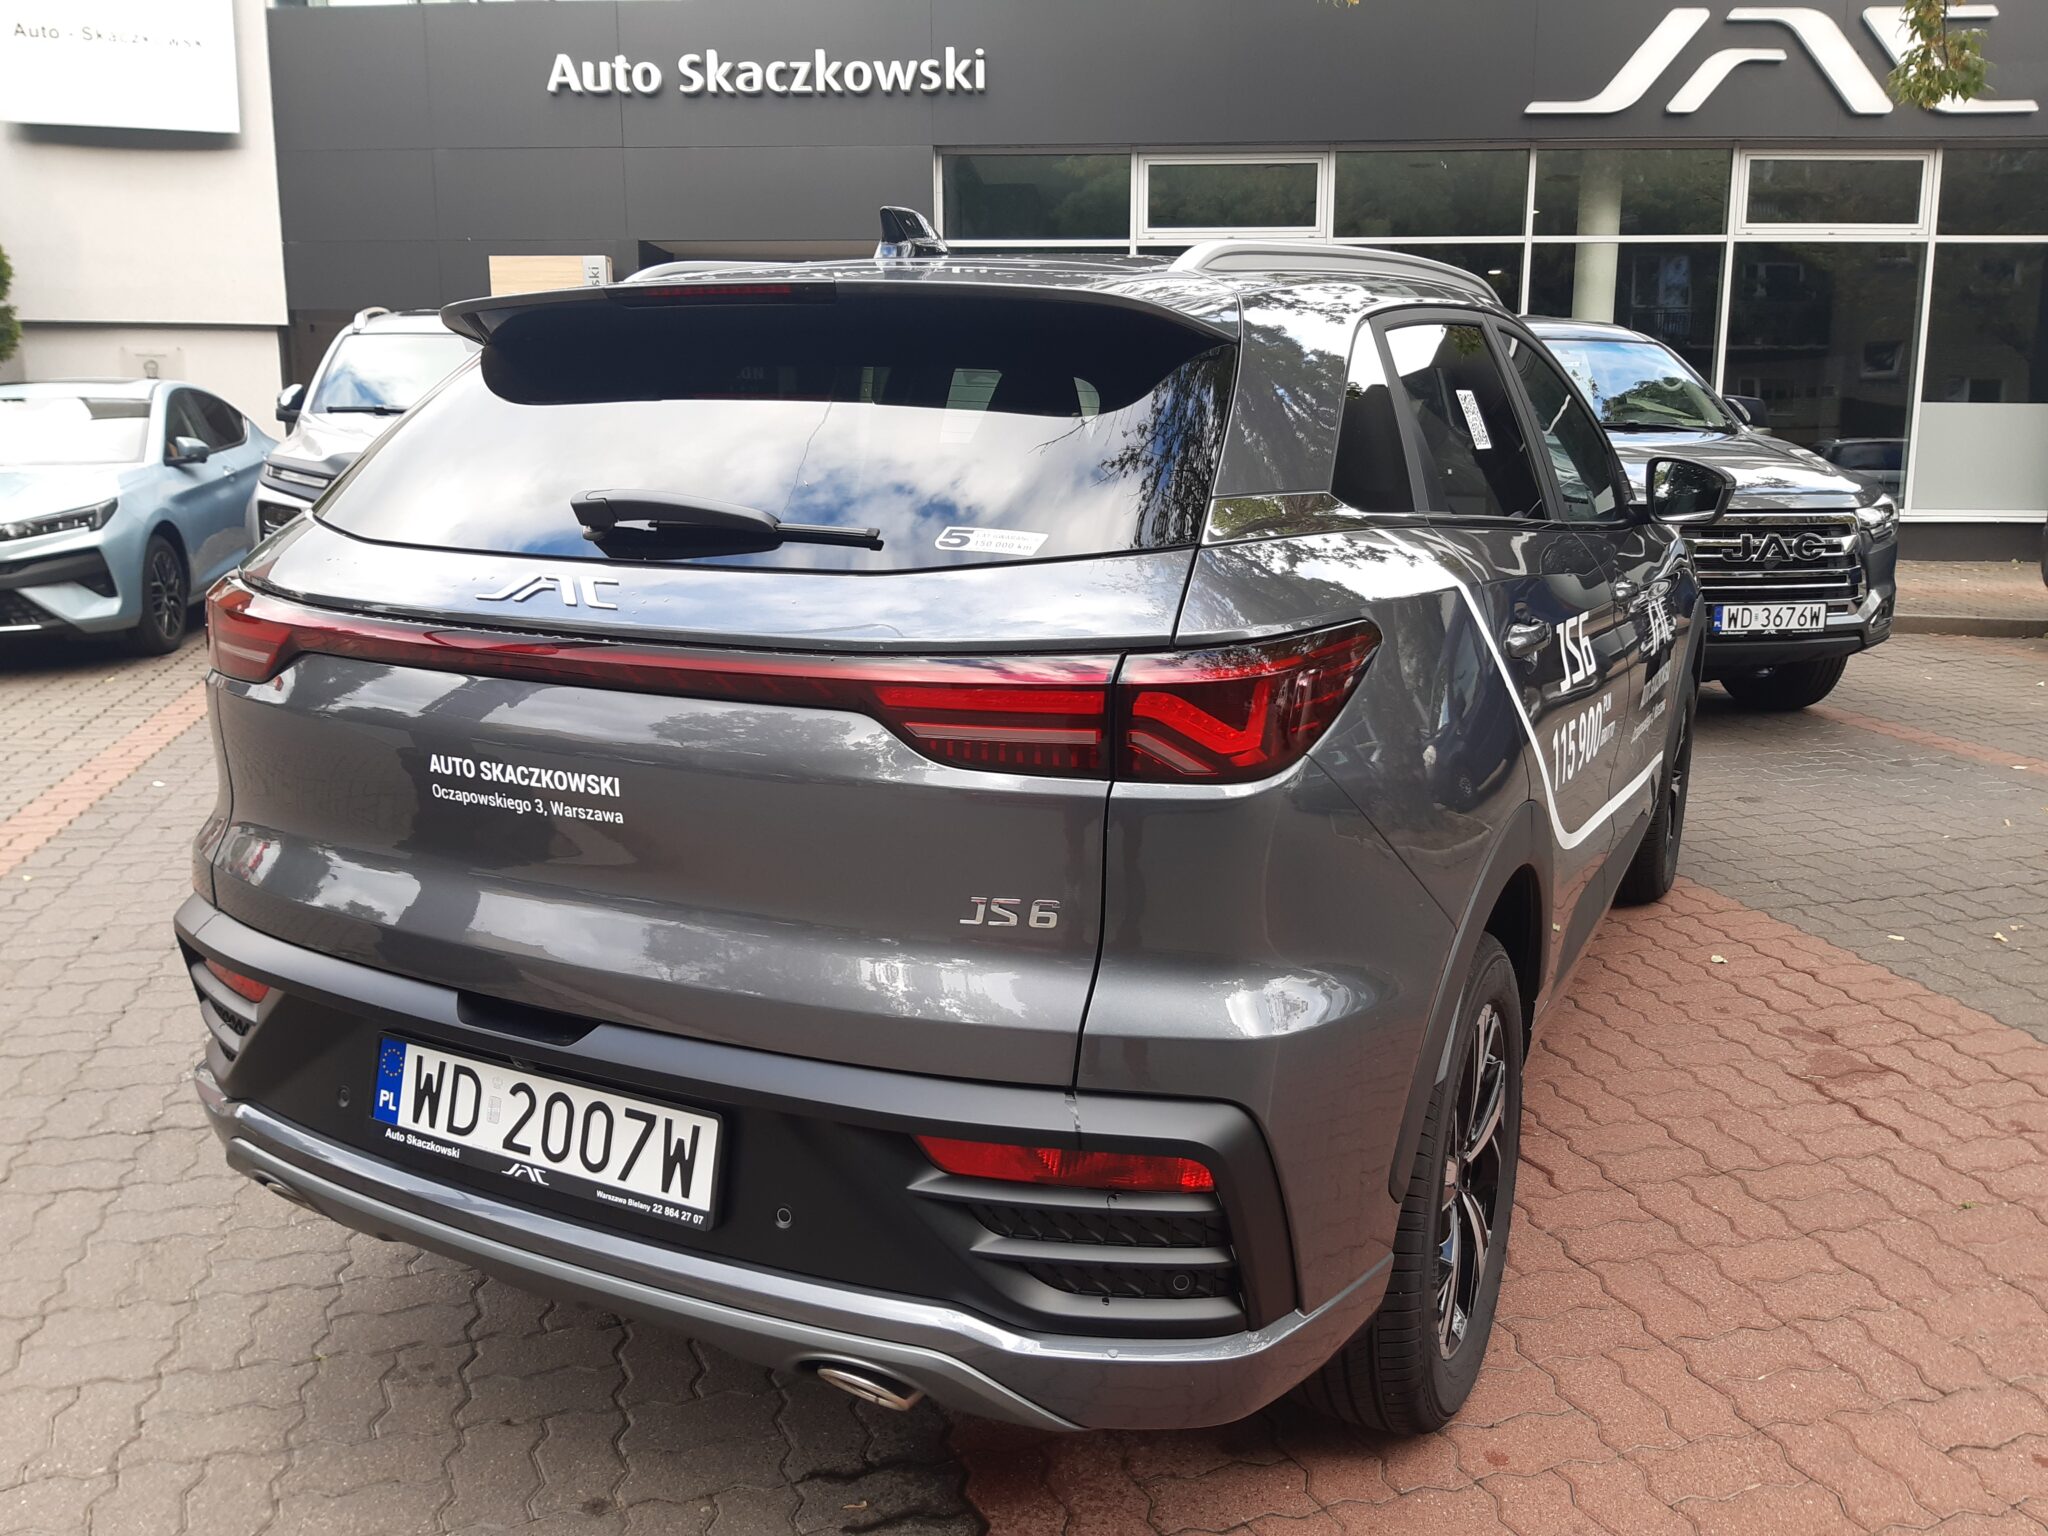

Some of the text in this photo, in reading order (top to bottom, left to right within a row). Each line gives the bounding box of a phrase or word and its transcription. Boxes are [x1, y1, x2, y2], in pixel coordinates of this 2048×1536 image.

[13, 22, 60, 39] Auto
[547, 46, 987, 95] Auto Skaczkowski
[1721, 532, 1827, 562] JAC
[1727, 606, 1822, 629] WD 3676W
[429, 753, 620, 797] AUTO SKACZKOWSKI
[432, 783, 624, 824] Oczapowskiego 3, Warszawa
[378, 1089, 397, 1111] PL
[385, 1127, 460, 1160] Auto Skaczkowski
[412, 1054, 701, 1200] WD 2007W
[596, 1189, 705, 1225] Warszawa Bielany 22 864 27 07
